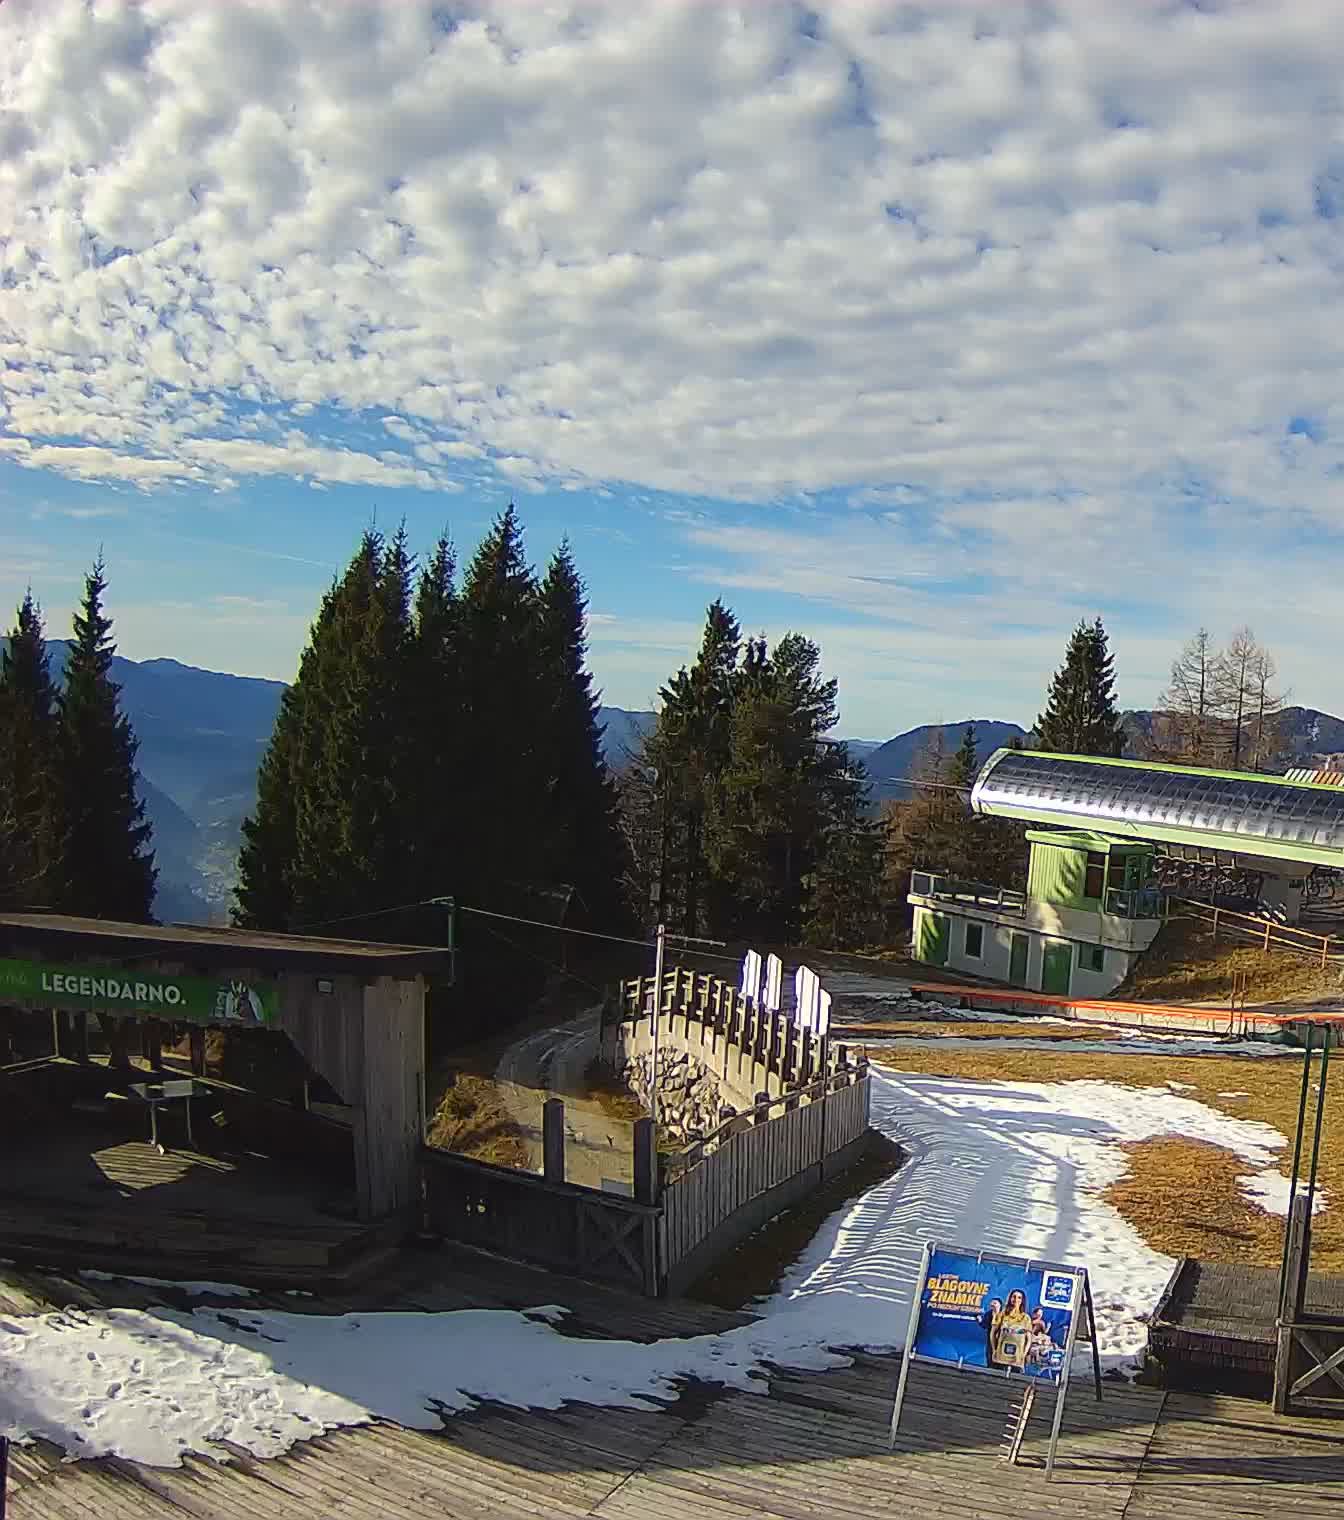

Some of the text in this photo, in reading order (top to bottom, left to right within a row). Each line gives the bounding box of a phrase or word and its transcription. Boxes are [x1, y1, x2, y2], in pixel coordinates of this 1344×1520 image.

[41, 972, 187, 1005] LEGENDARNO.
[927, 1278, 991, 1295] BLAGOVNE
[929, 1290, 983, 1306] ZNAMKE
